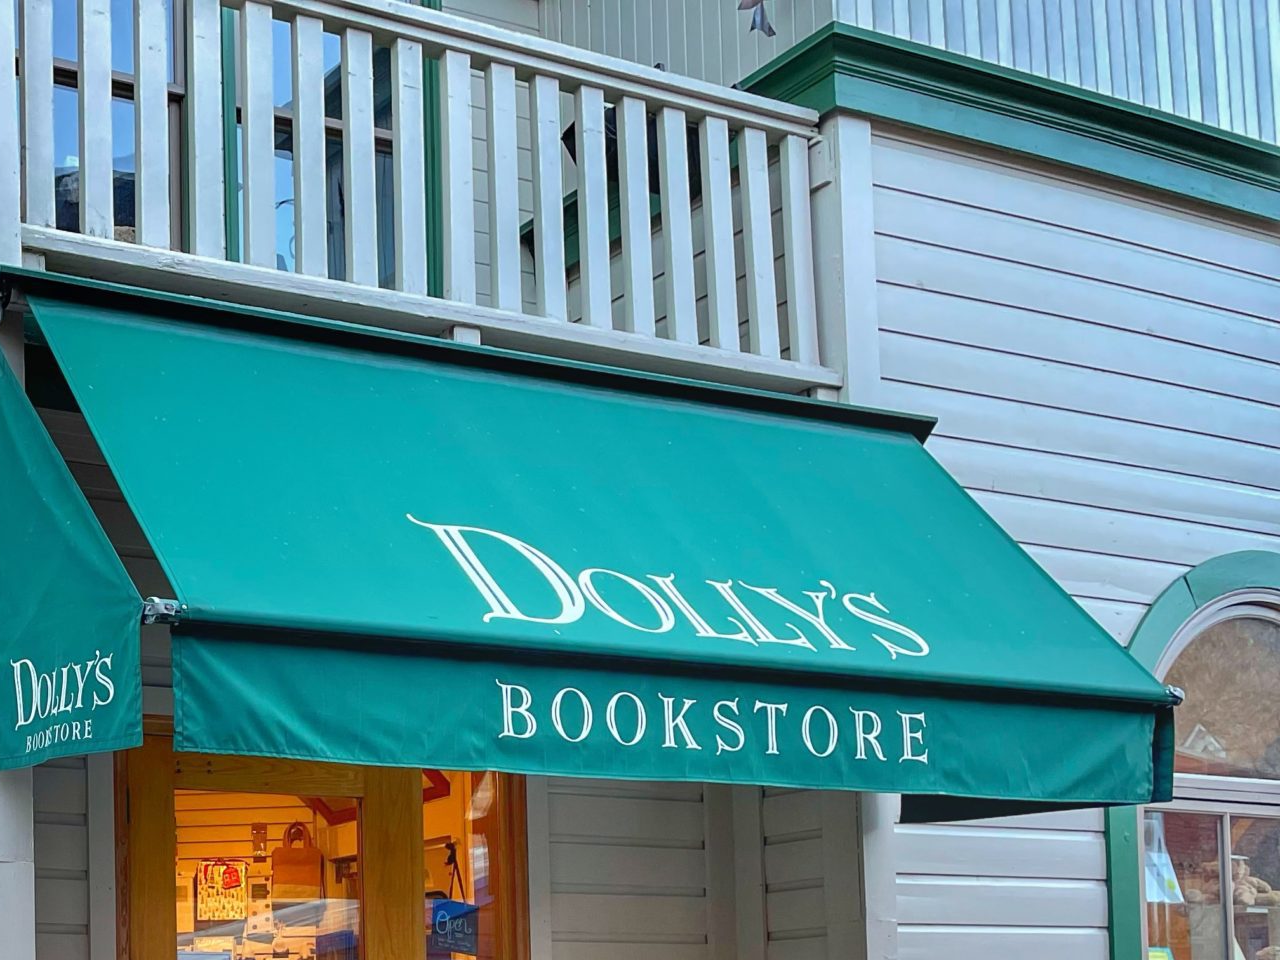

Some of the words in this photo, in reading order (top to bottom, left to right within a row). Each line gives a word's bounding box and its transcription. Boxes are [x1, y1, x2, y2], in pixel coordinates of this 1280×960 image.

[406, 512, 931, 661] DOLLY'S
[9, 649, 116, 732] DOLLY'S
[496, 678, 929, 765] BOOKSTORE
